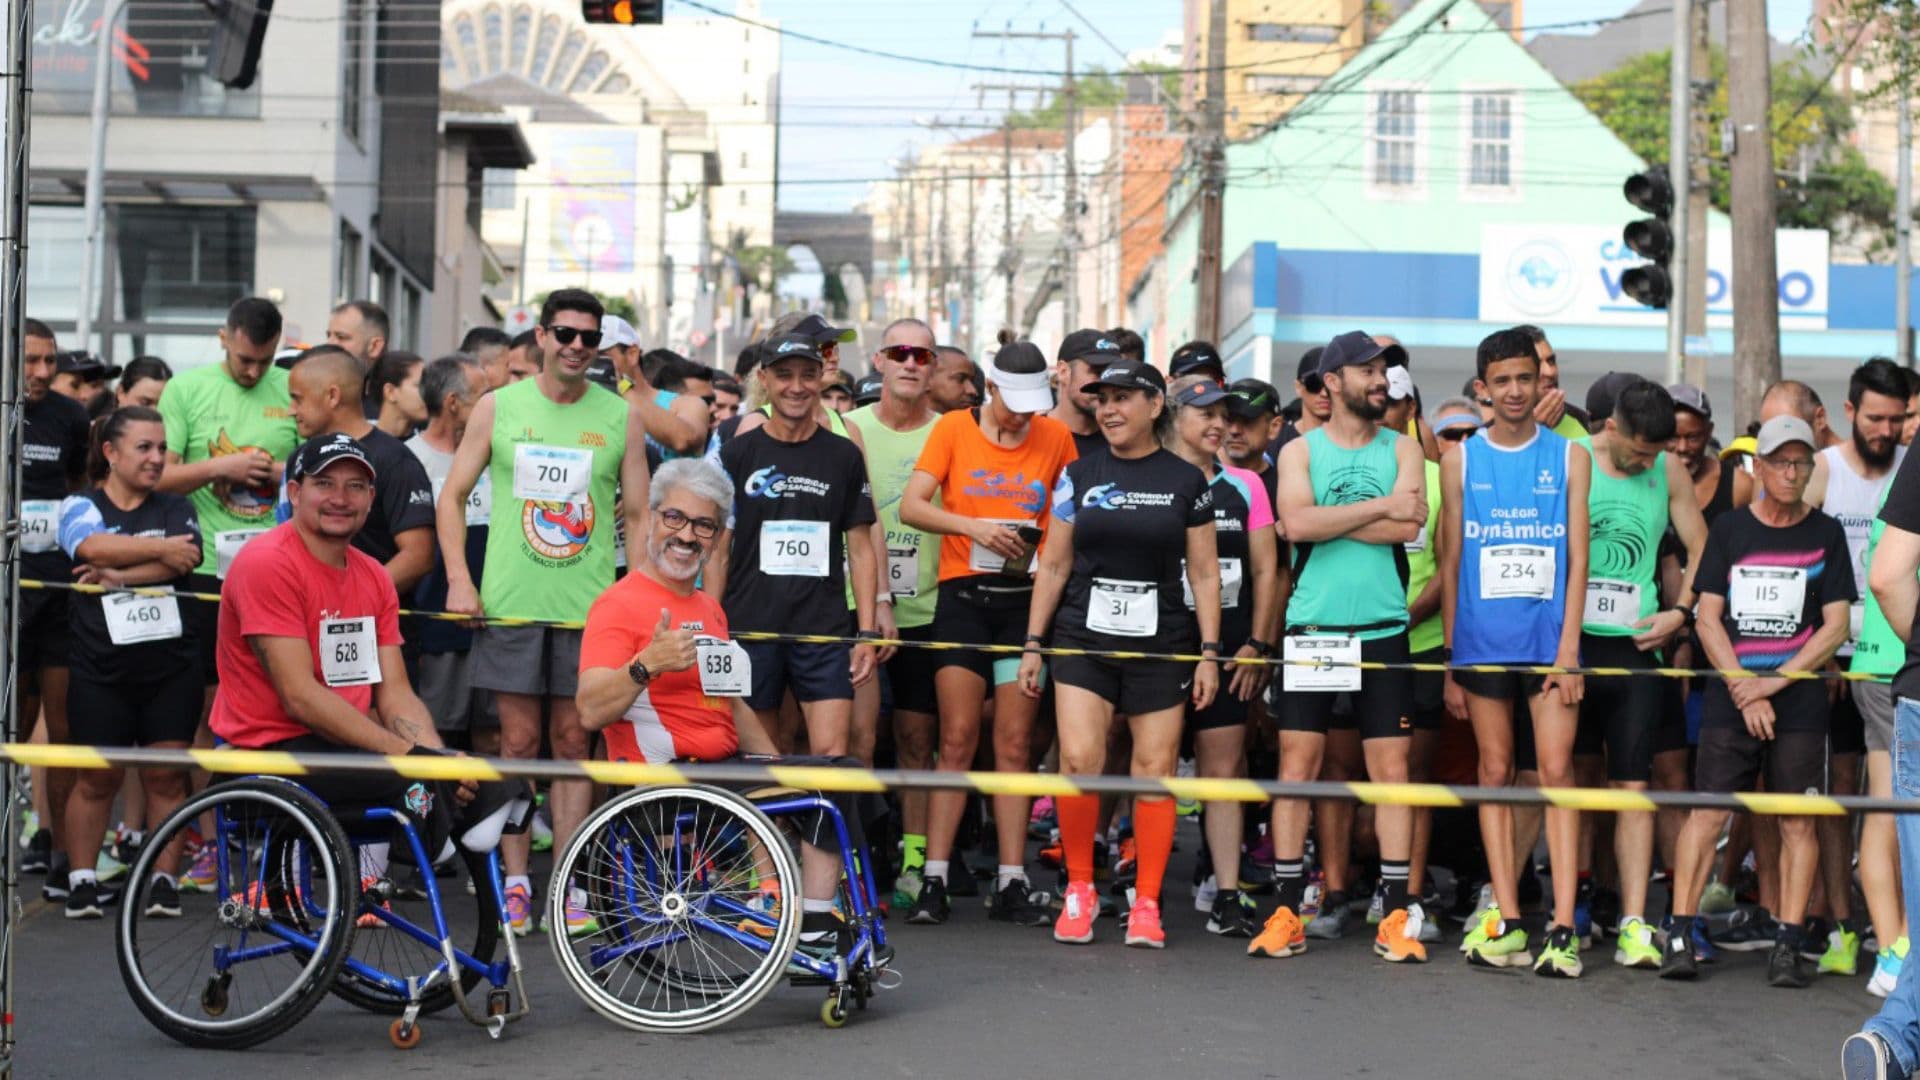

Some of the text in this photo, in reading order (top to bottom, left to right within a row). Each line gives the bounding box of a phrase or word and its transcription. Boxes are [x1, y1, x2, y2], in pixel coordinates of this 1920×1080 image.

[537, 465, 567, 483] 701
[787, 475, 831, 490] CORRIDAS
[1126, 492, 1174, 500] CORRIDAS
[1490, 507, 1538, 519] COLÉGIO
[885, 531, 922, 546] PIRE
[1464, 520, 1566, 543] Dynâmico
[775, 540, 810, 556] 760
[1500, 563, 1536, 579] 234
[1756, 585, 1779, 601] 115
[1111, 599, 1128, 616] 31
[1598, 597, 1615, 613] 81
[126, 606, 161, 624] 460
[335, 642, 358, 663] 628
[706, 655, 732, 673] 638
[1311, 655, 1334, 672] 73
